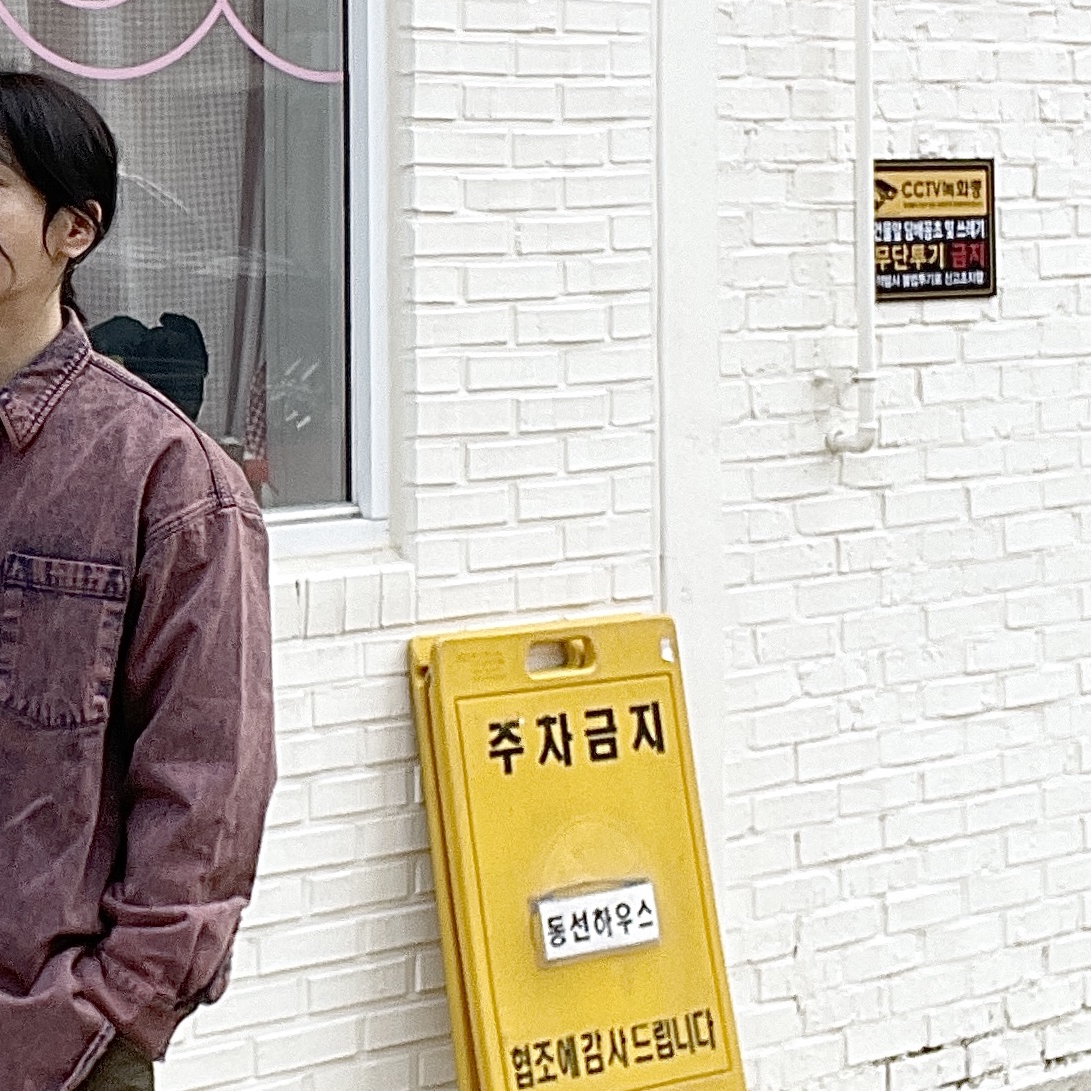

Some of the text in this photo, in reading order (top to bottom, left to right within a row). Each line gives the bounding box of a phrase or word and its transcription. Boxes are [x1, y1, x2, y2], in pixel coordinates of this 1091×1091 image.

[875, 240, 985, 271] 무단투기 금지
[487, 700, 666, 775] 주차금지
[546, 897, 654, 949] 동선하우스
